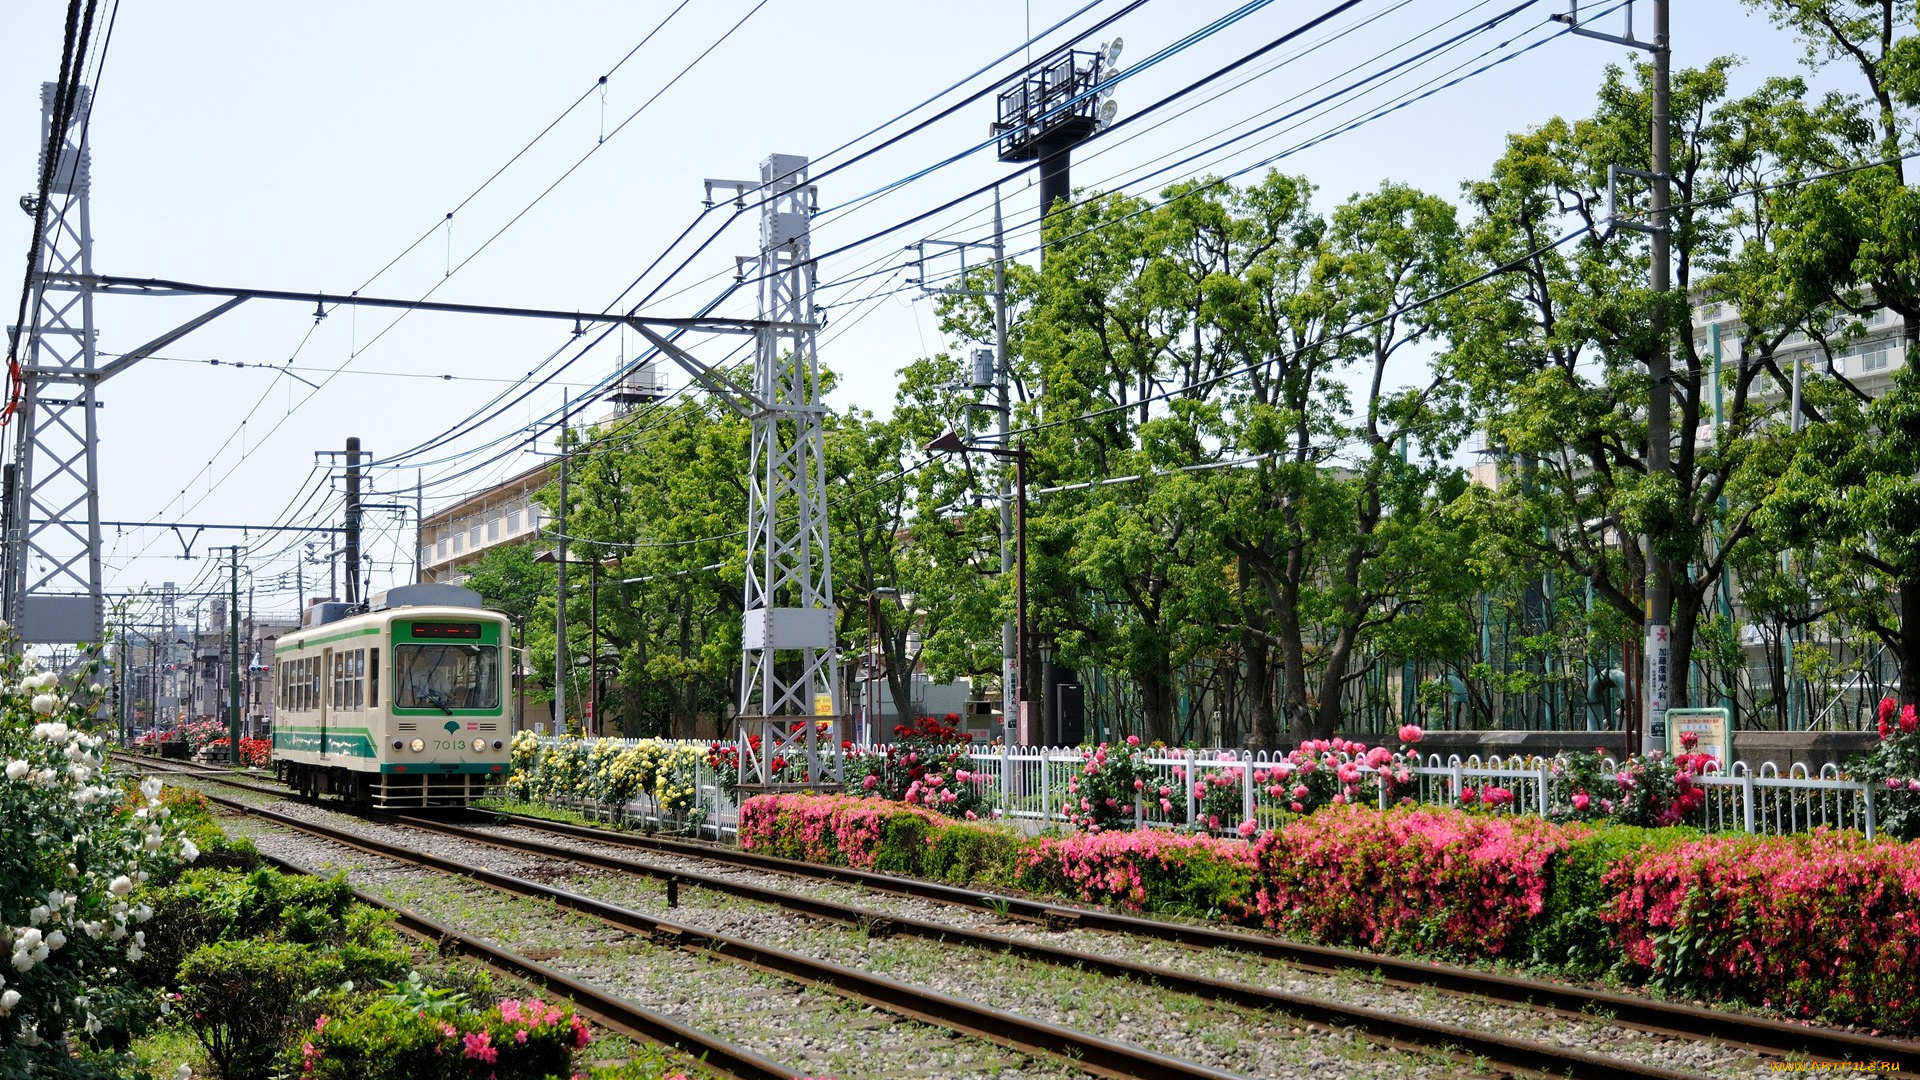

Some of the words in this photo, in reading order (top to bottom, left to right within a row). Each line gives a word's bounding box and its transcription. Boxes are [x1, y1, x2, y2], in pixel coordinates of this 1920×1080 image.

[1658, 648, 1667, 700] 加藤産婦人科
[433, 740, 466, 750] 7013
